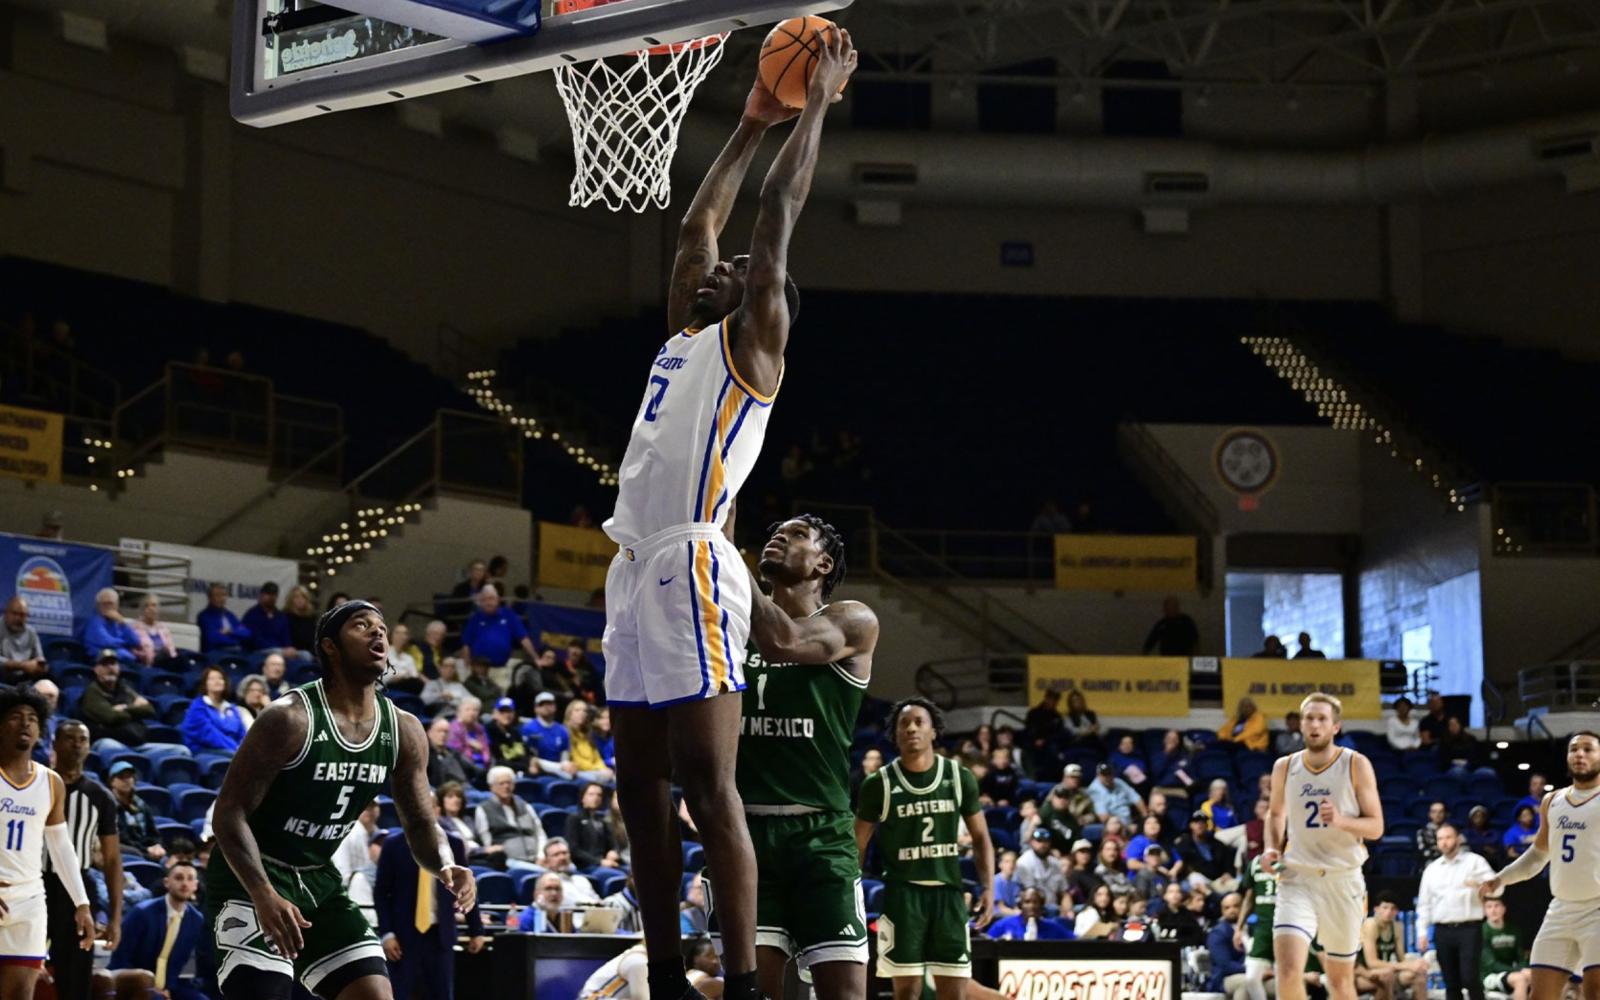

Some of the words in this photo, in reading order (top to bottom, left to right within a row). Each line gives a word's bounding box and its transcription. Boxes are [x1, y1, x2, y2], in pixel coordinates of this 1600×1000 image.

[757, 673, 768, 710] 1
[750, 717, 814, 738] MEXICO
[313, 761, 388, 784] EASTERN
[1299, 783, 1331, 797] Rams
[0, 797, 37, 816] Rams
[330, 785, 356, 820] 5
[896, 799, 956, 818] EASTERN
[1304, 800, 1328, 829] 2
[6, 819, 25, 851] 11
[284, 816, 321, 838] NEW
[320, 820, 357, 841] MEX
[921, 816, 935, 843] 2
[1556, 815, 1587, 831] Rams
[898, 846, 920, 861] NEW
[1561, 834, 1577, 863] 5
